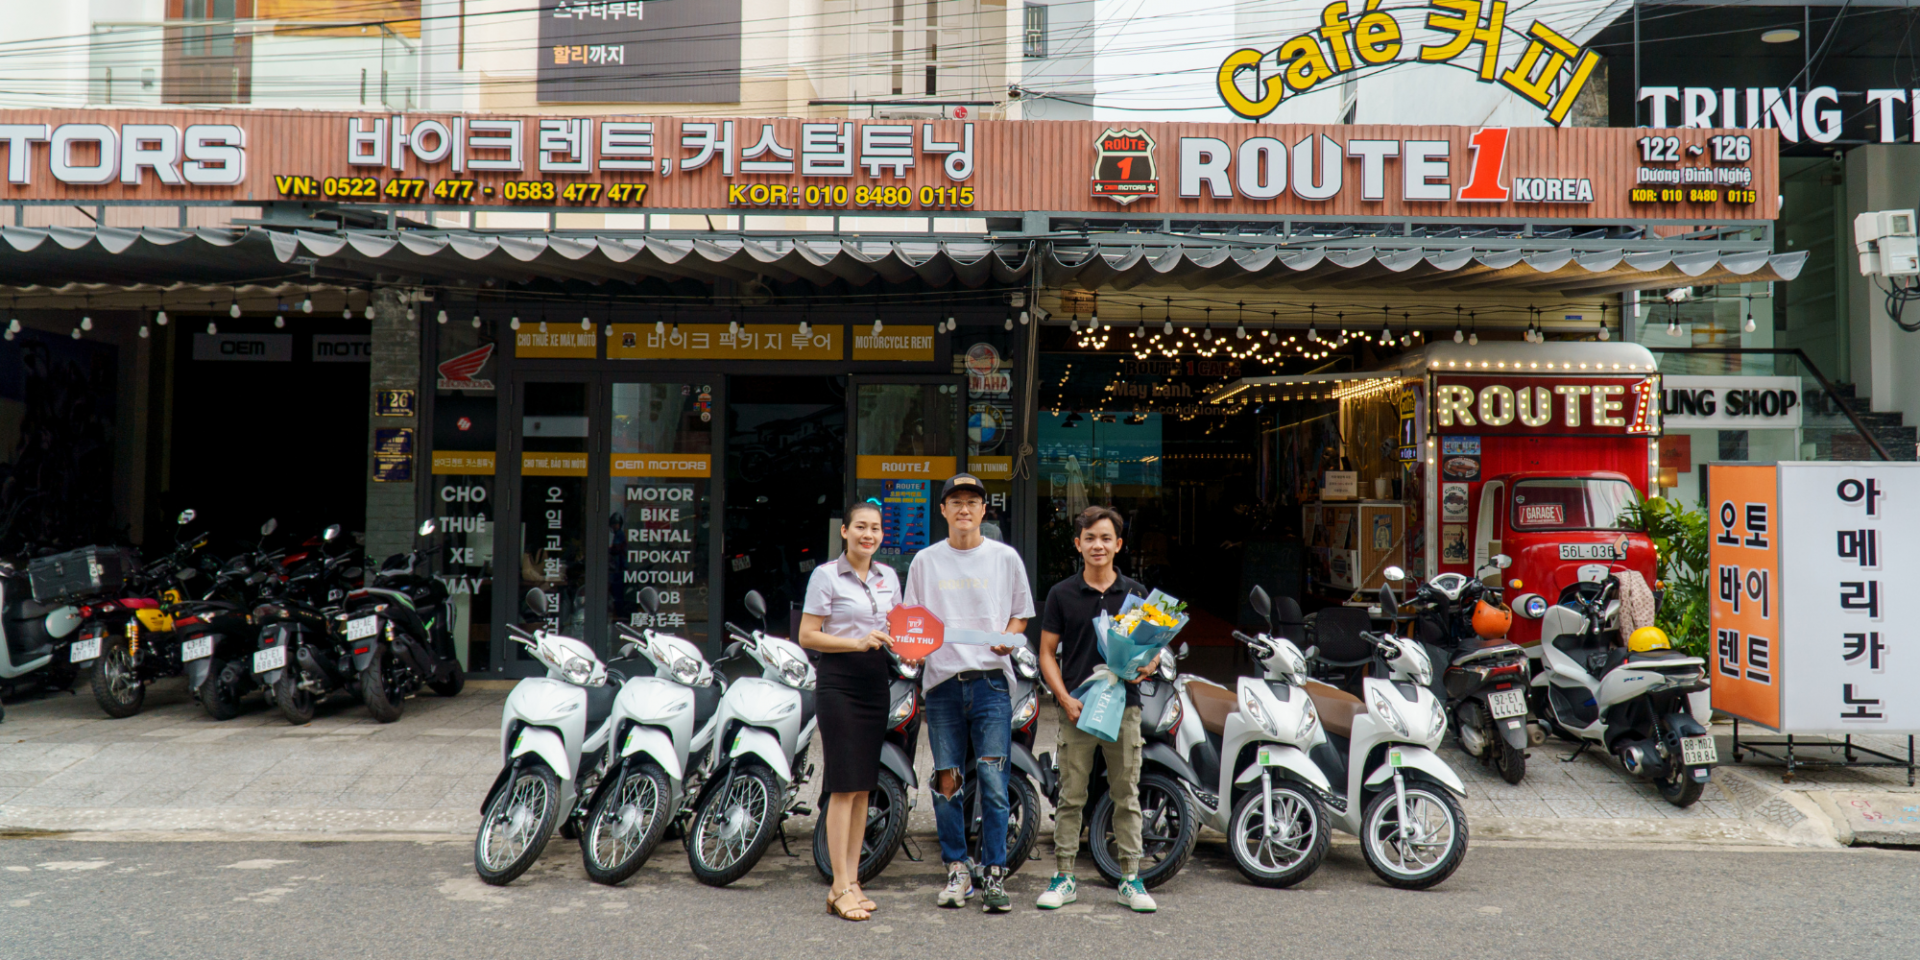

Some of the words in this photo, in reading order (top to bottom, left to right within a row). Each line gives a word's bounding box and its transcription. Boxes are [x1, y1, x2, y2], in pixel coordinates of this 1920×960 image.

[553, 45, 625, 65] 할리까지
[1216, 0, 1403, 120] Café
[1416, 0, 1602, 127] 커피
[348, 116, 524, 173] 바이크
[1104, 137, 1146, 151] ROUTE
[1638, 136, 1681, 163] 122
[1709, 135, 1751, 163] 126
[1117, 157, 1133, 180] 1
[275, 176, 319, 197] VN:
[323, 177, 378, 198] 0522
[385, 178, 427, 199] 477
[434, 179, 475, 200] 477
[504, 181, 556, 201] 0583
[563, 183, 603, 203] 477
[608, 183, 648, 203] 477
[805, 185, 849, 207] 010
[855, 186, 912, 208] 8480
[919, 186, 976, 208] 0115
[1514, 177, 1595, 203] KOREA
[1632, 189, 1658, 203] KOR:
[1661, 189, 1683, 203] 010
[1690, 189, 1718, 203] 8480
[1727, 190, 1756, 204] 0115
[517, 332, 531, 347] CHO
[550, 333, 559, 347] XE
[855, 335, 909, 350] MOTORCYCLE
[911, 335, 933, 350] RENT
[220, 340, 265, 356] OEM
[1185, 360, 1195, 376] 1
[381, 392, 408, 407] 126
[1724, 389, 1798, 417] SHOP
[615, 460, 644, 470] OEM
[648, 460, 707, 471] MOTORS
[983, 463, 1008, 473] TUNING
[441, 486, 486, 503] CHO
[627, 487, 695, 502] MOTOR
[640, 508, 680, 522] BIKE
[1526, 506, 1556, 519] GARAGE
[439, 512, 486, 533] THUÊ
[628, 529, 692, 543] RENTAL
[450, 547, 475, 563] XE
[628, 550, 691, 563] ПРОКАТ
[444, 573, 484, 595] MÁY
[623, 571, 694, 586] МОТОЦИ
[916, 636, 934, 645] THU
[1493, 692, 1518, 706] 92-E1
[1685, 749, 1716, 763] 038.84
